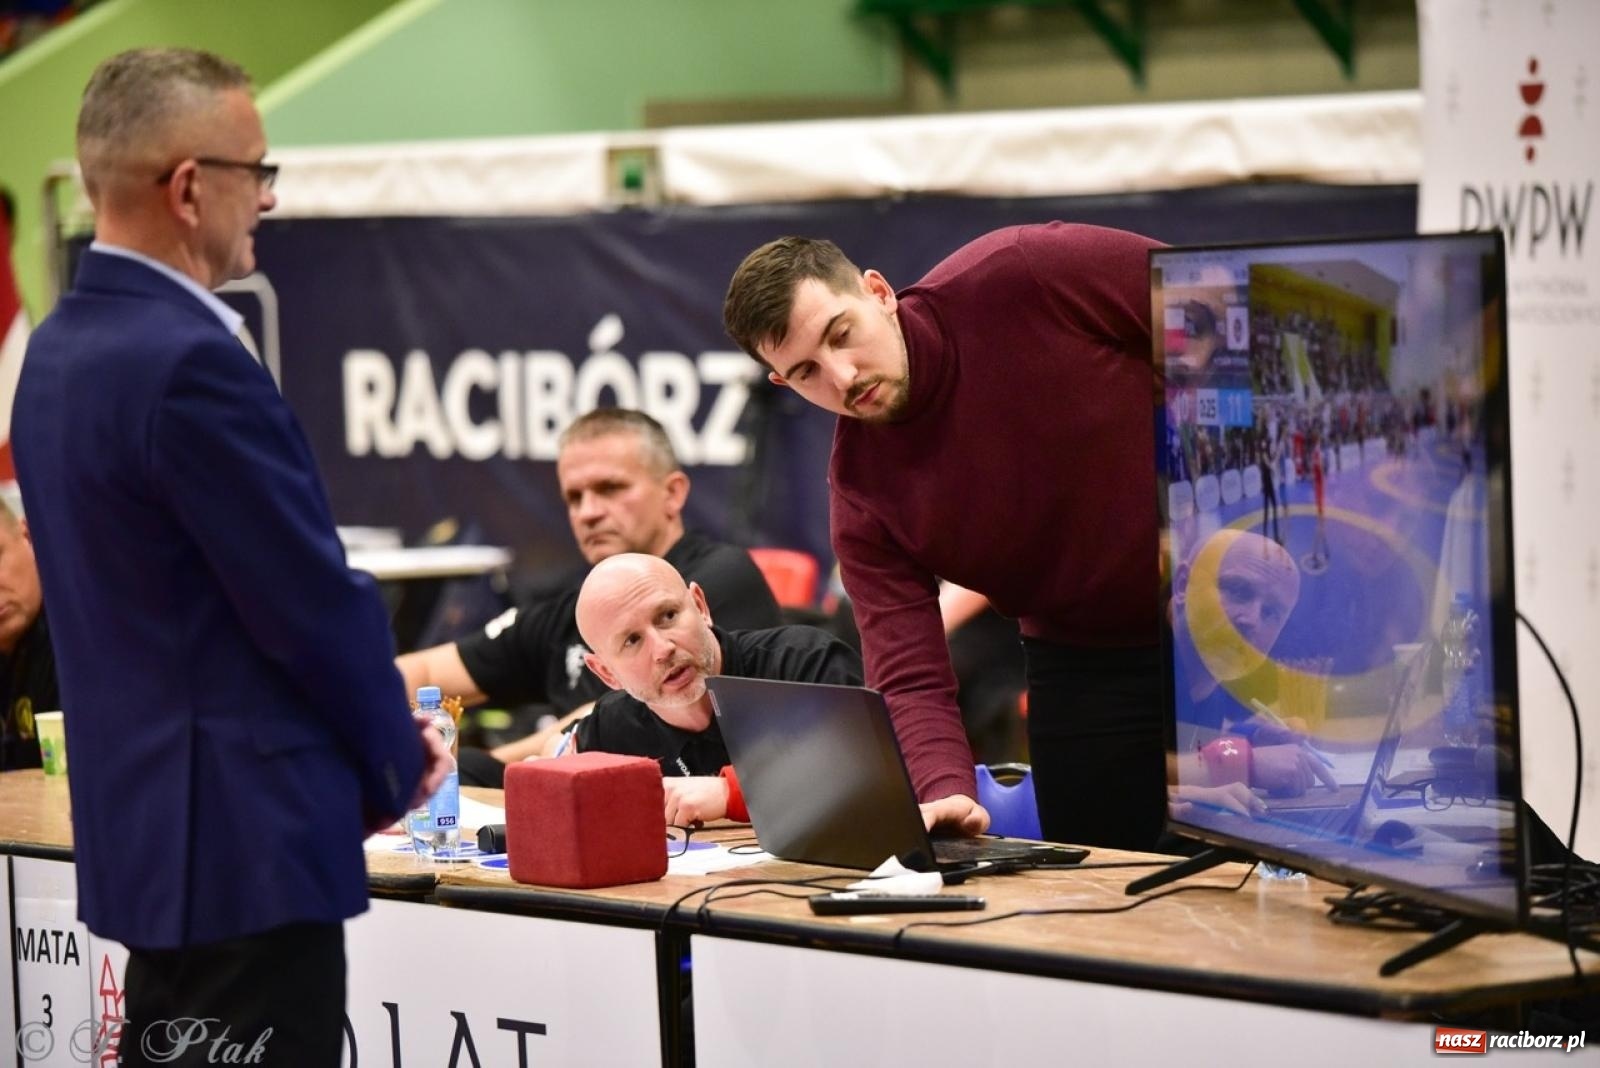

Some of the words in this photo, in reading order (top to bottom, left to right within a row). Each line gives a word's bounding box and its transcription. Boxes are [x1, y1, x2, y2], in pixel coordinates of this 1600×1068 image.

[341, 313, 758, 466] RACIBÓRZ
[17, 927, 80, 966] MATA
[41, 993, 54, 1029] 3
